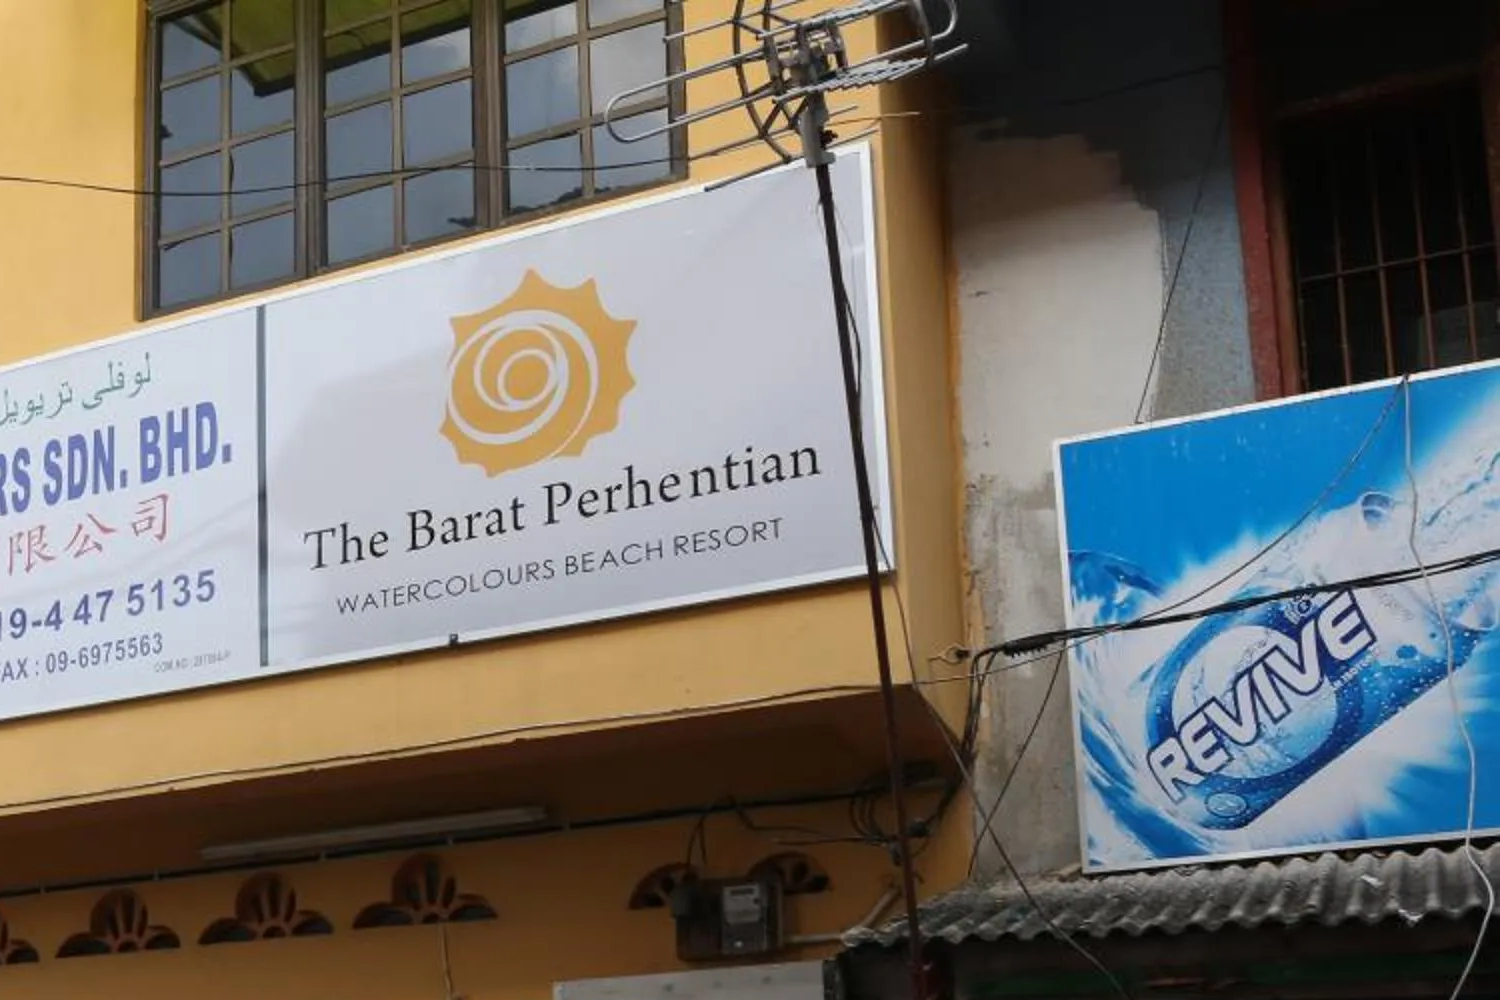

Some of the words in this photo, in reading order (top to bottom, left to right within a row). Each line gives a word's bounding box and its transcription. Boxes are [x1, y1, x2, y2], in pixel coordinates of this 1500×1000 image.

[42, 425, 128, 506] SDN.
[139, 400, 233, 484] BHD.
[304, 522, 389, 570] The
[406, 496, 526, 553] Barat
[543, 445, 823, 526] Perhentian
[336, 558, 555, 615] WATERCOLOURS
[565, 538, 663, 576] BEACH
[673, 516, 784, 556] RESORT
[1146, 586, 1377, 803] REVIVE
